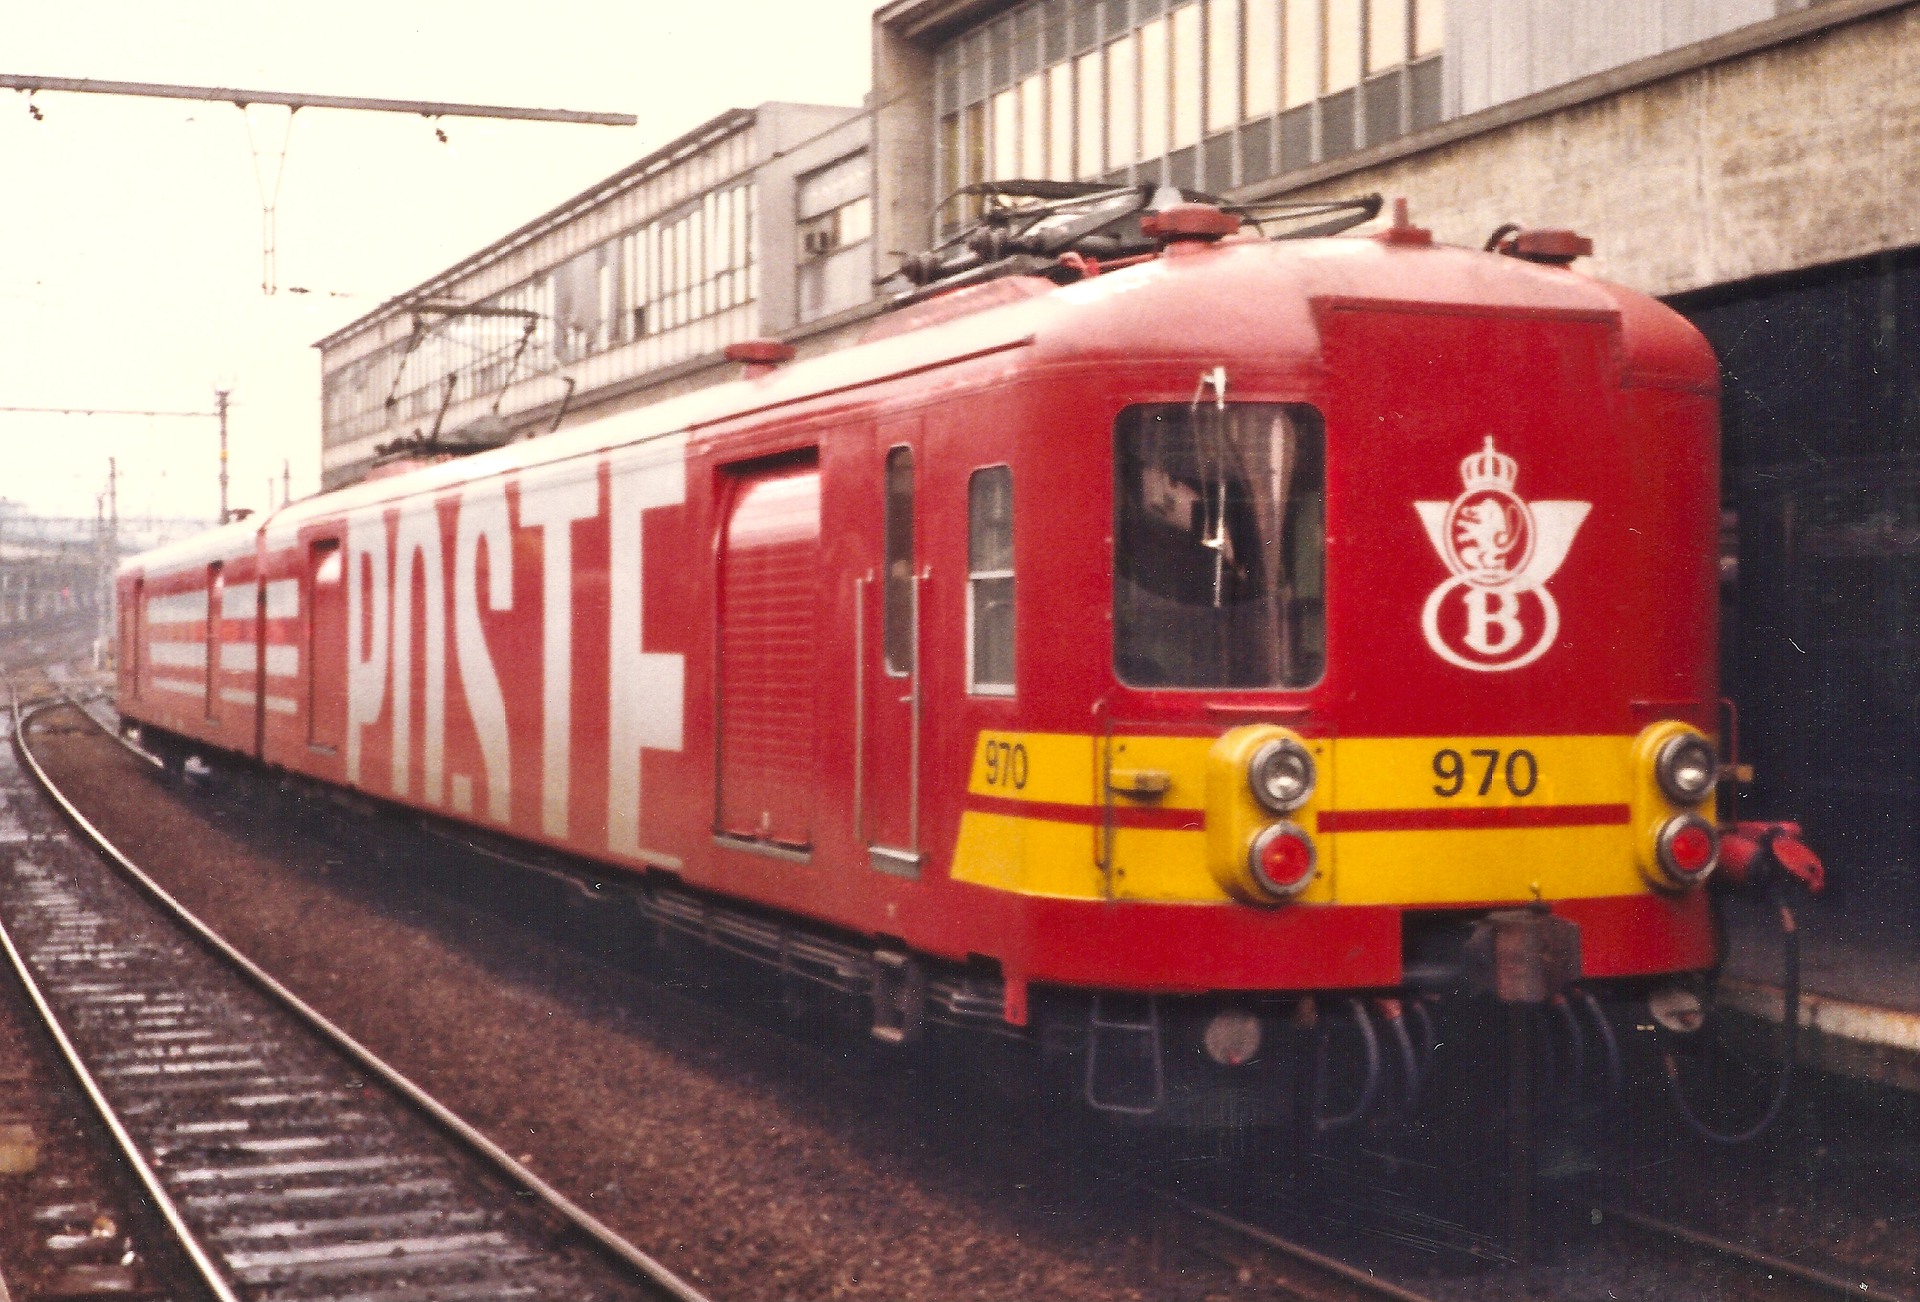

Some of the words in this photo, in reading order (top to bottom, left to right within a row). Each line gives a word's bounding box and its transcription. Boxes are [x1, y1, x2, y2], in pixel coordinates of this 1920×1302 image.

[346, 432, 686, 870] POSTE
[985, 739, 1028, 790] 970
[1432, 748, 1538, 798] 970
